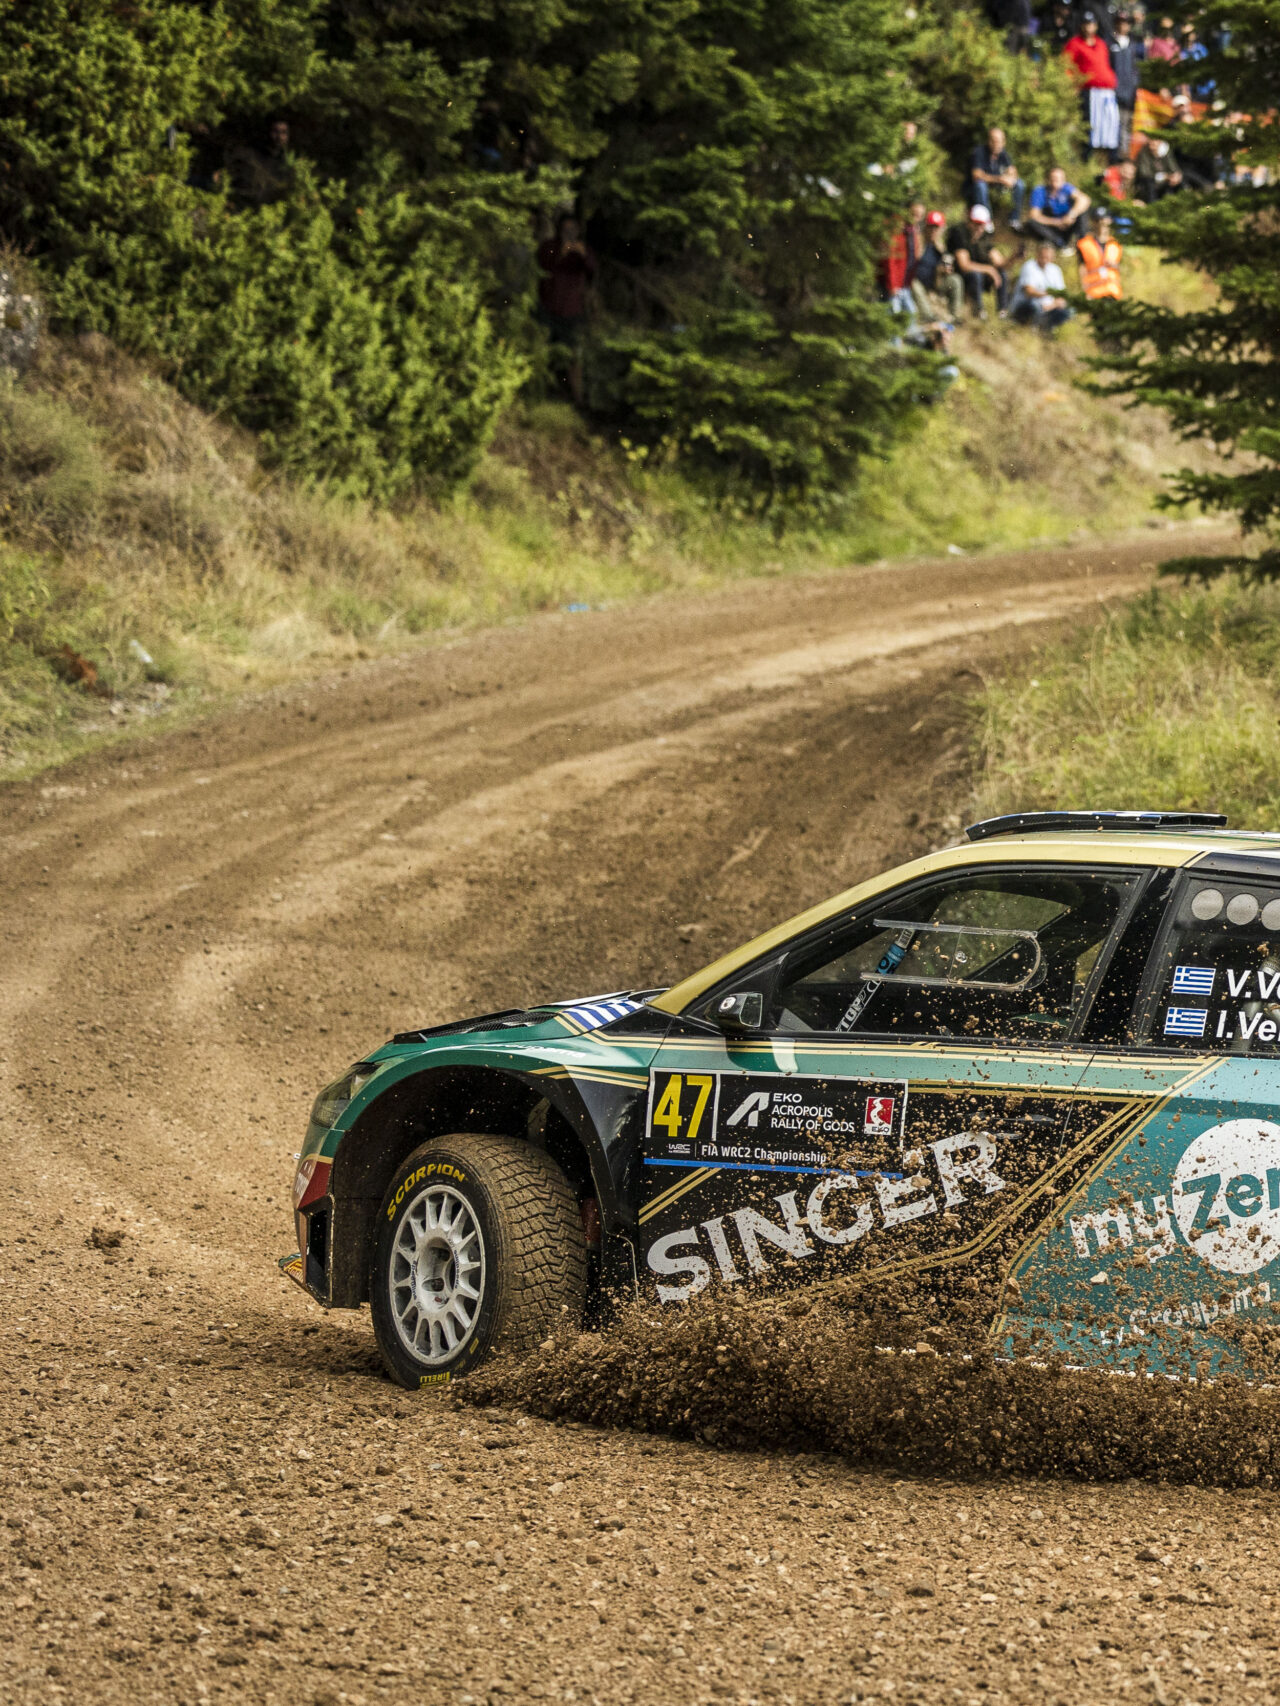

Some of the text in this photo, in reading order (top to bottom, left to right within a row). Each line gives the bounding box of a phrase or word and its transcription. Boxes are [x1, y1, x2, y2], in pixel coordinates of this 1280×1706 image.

[653, 1074, 713, 1138] 47
[773, 1092, 803, 1104] EKO
[771, 1105, 834, 1118] ACROPOLIS
[770, 1118, 855, 1133] RALLY OF GODS
[701, 1144, 827, 1165] FIA WRC2 Championship
[387, 1162, 465, 1222] SCORPION
[647, 1130, 1007, 1305] SINGER
